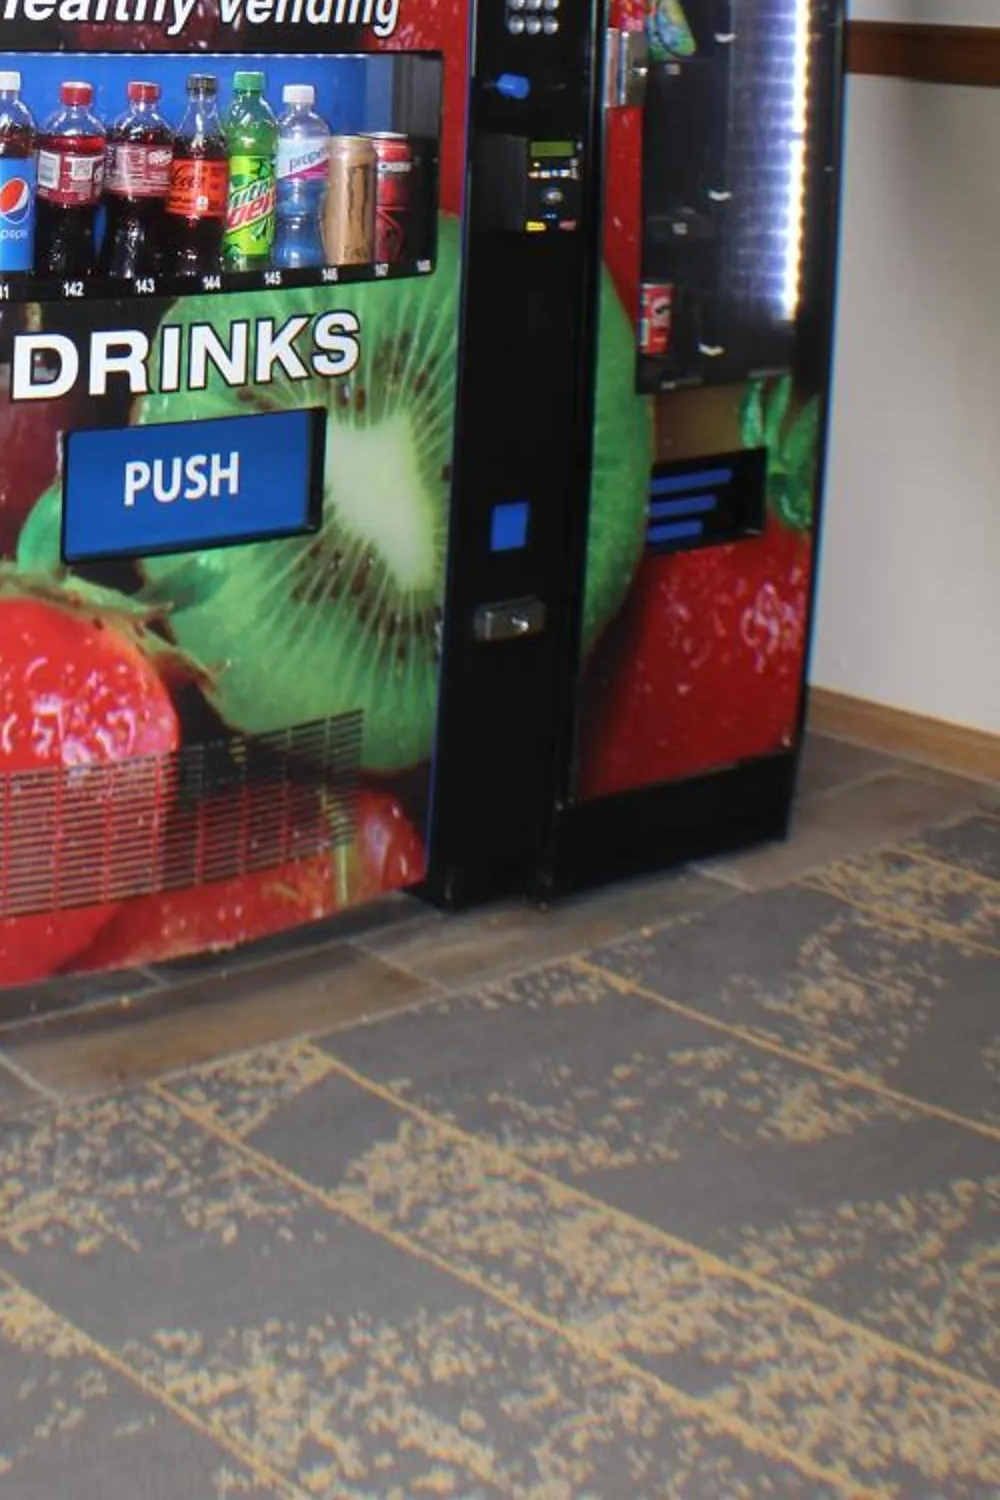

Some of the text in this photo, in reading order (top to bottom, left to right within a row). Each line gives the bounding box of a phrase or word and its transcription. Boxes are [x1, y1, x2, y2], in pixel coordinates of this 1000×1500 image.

[135, 277, 155, 293] 143
[264, 271, 281, 286] 145
[63, 280, 84, 297] 142
[11, 309, 361, 401] DRINKS
[123, 451, 239, 506] PUSH
